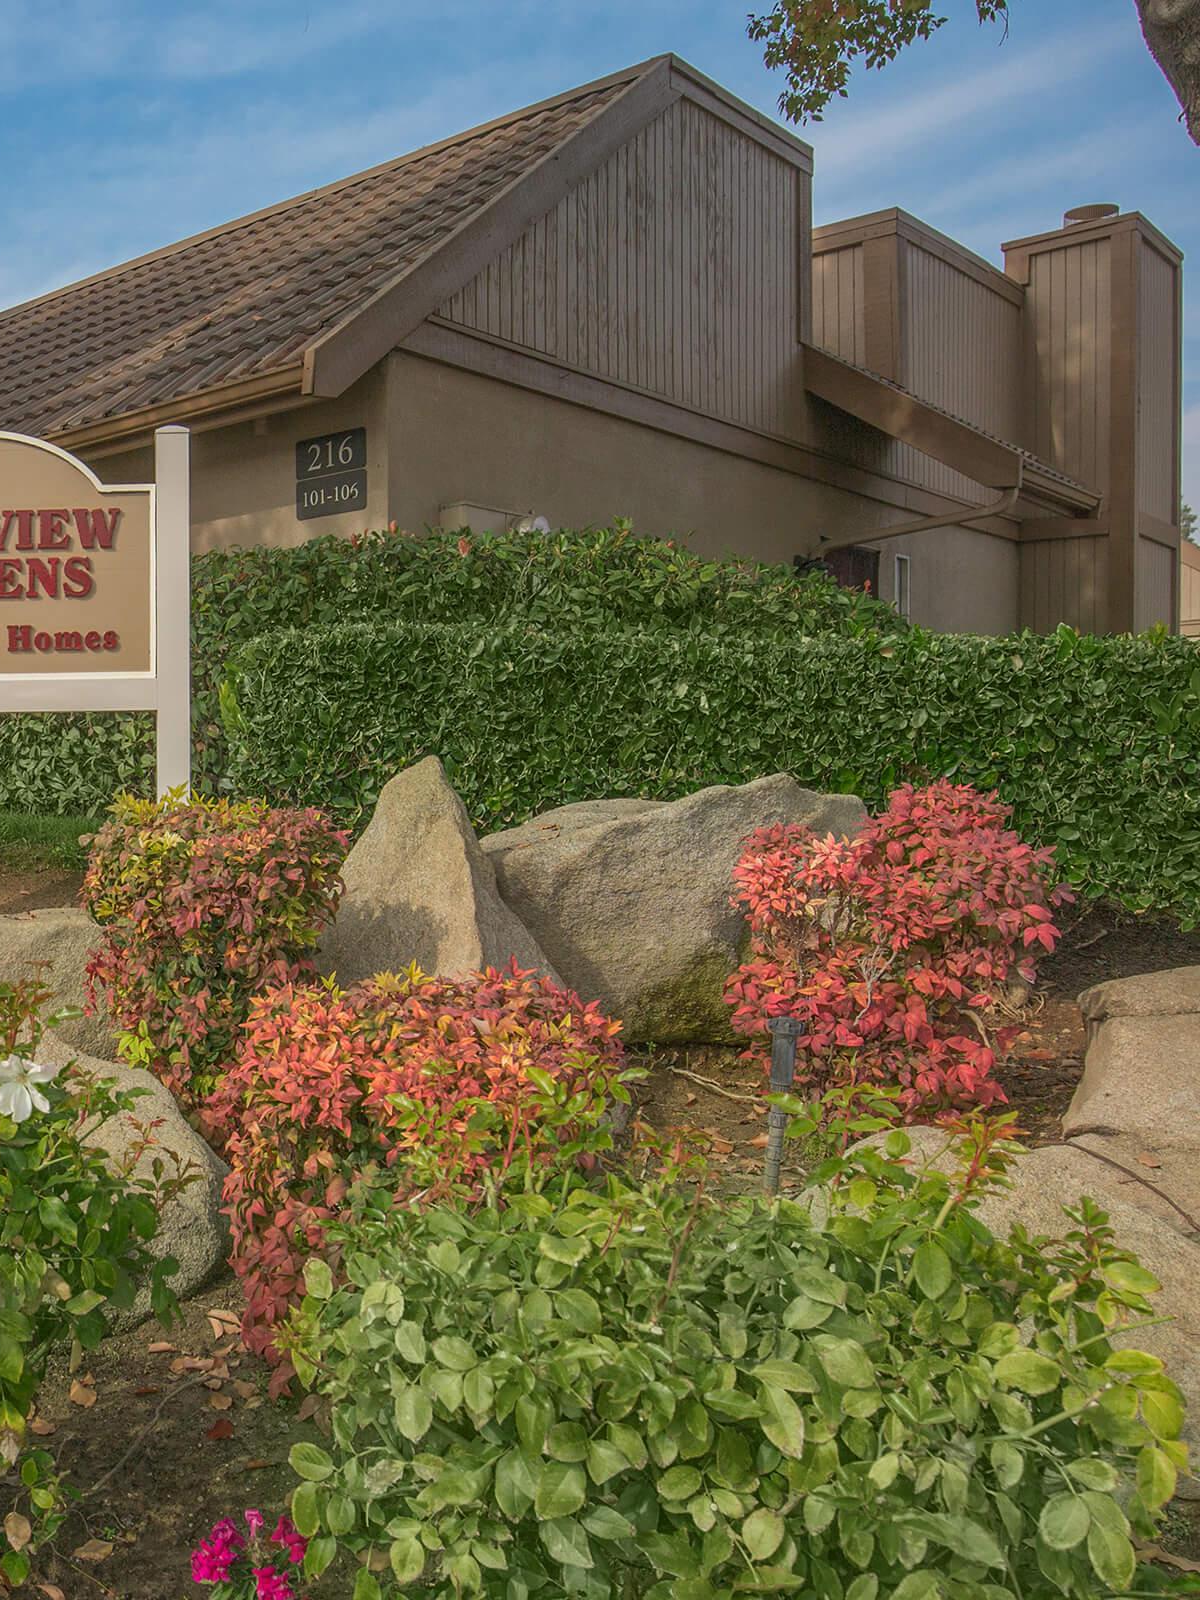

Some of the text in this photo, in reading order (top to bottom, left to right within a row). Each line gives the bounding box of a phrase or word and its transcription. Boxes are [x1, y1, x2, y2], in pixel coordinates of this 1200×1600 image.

[307, 435, 353, 472] 216
[303, 482, 359, 507] 101-106
[6, 625, 120, 655] Homes
